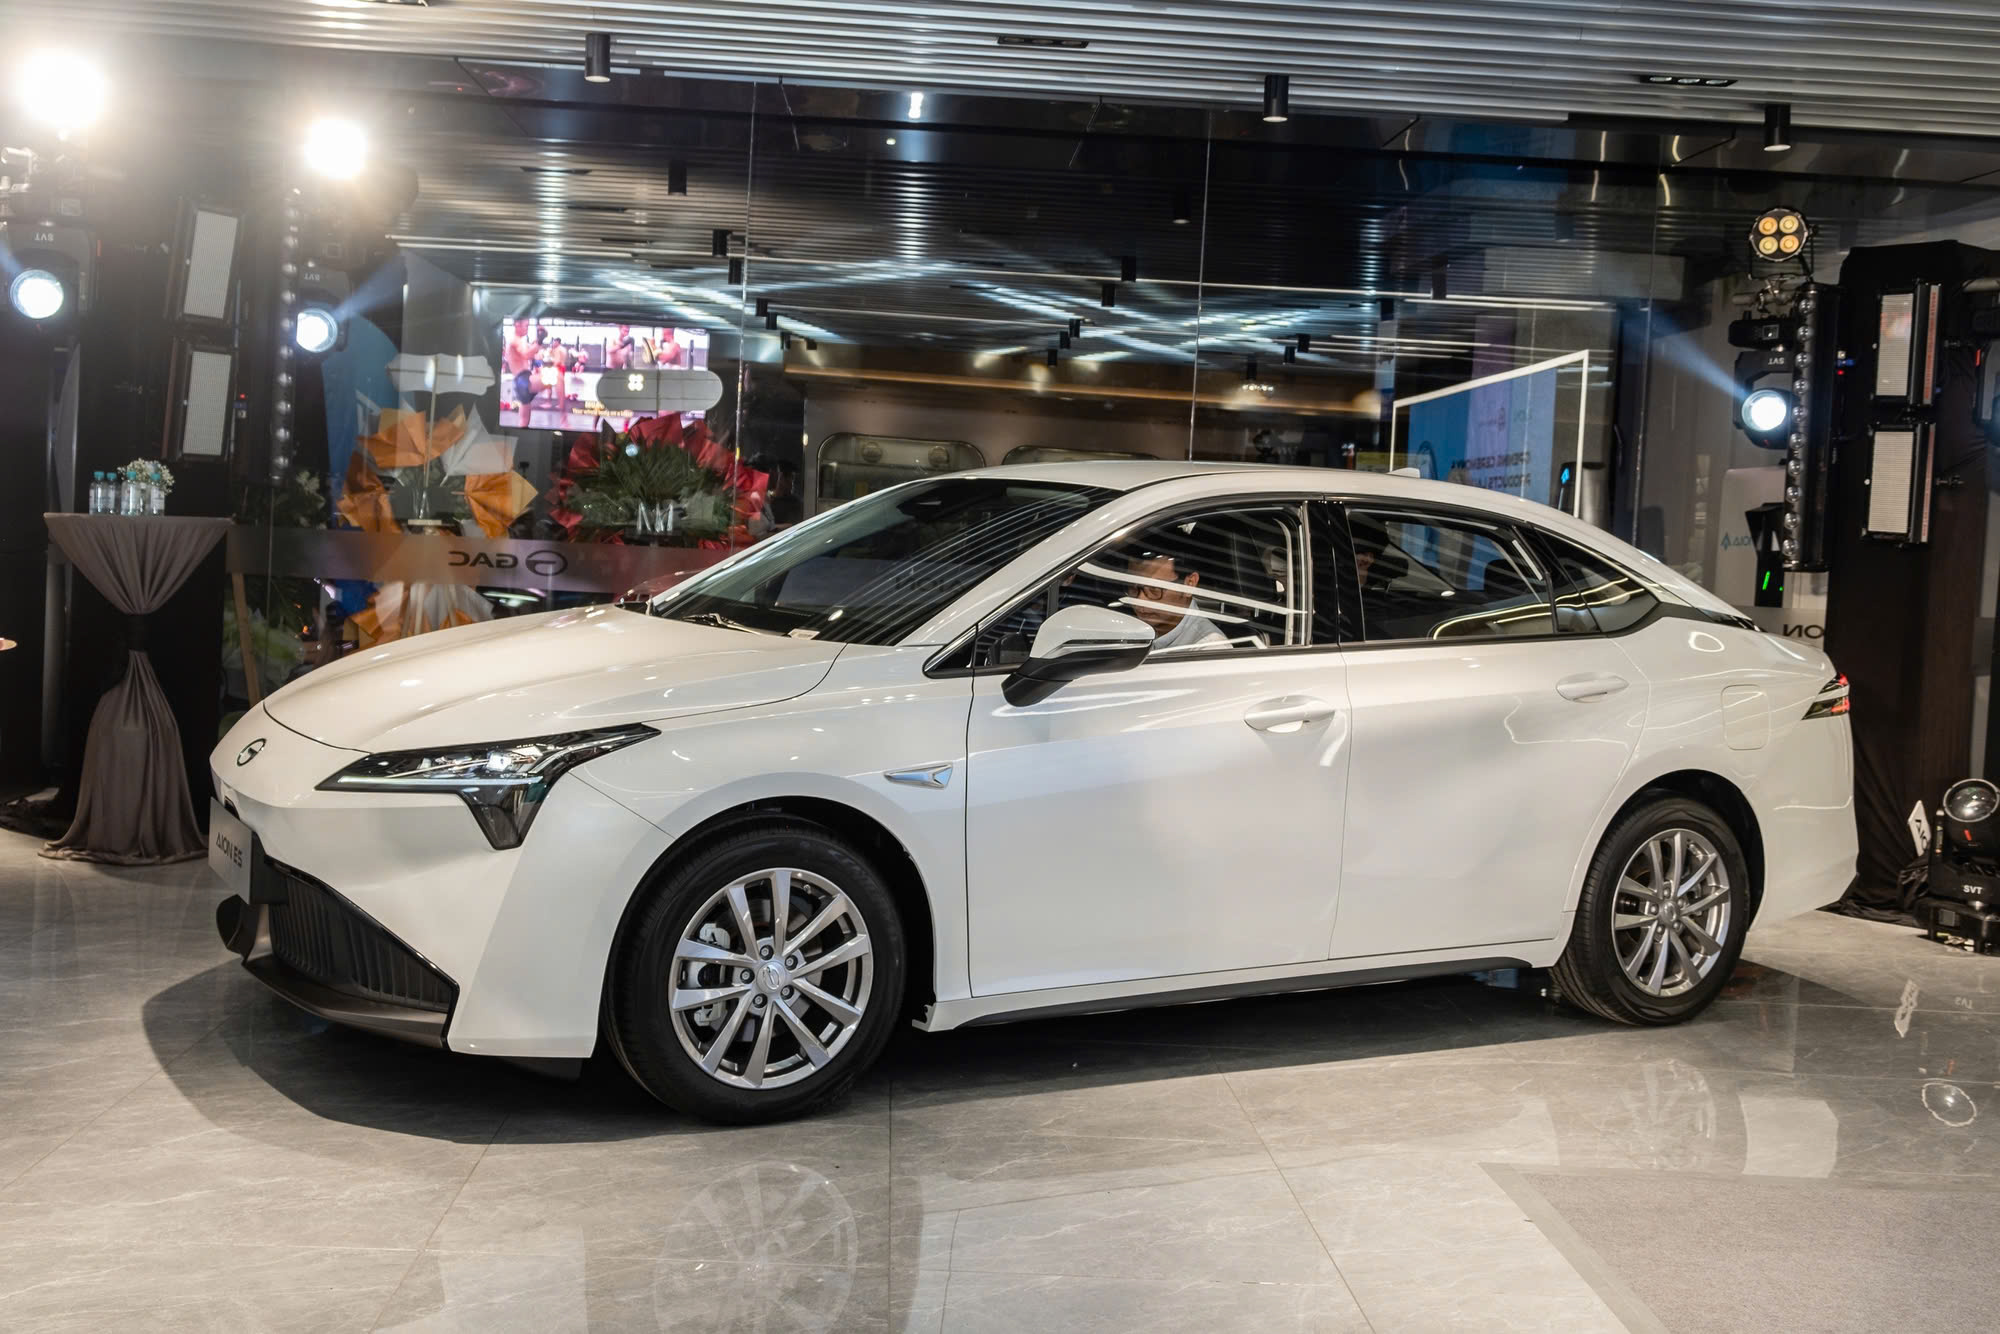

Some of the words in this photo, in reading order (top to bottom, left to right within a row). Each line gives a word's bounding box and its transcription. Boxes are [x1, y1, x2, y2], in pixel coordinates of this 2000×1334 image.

[34, 232, 54, 241] SVT
[1767, 357, 1784, 365] SVT
[216, 832, 233, 860] AION
[233, 845, 243, 868] ES
[1963, 884, 1983, 895] SVT
